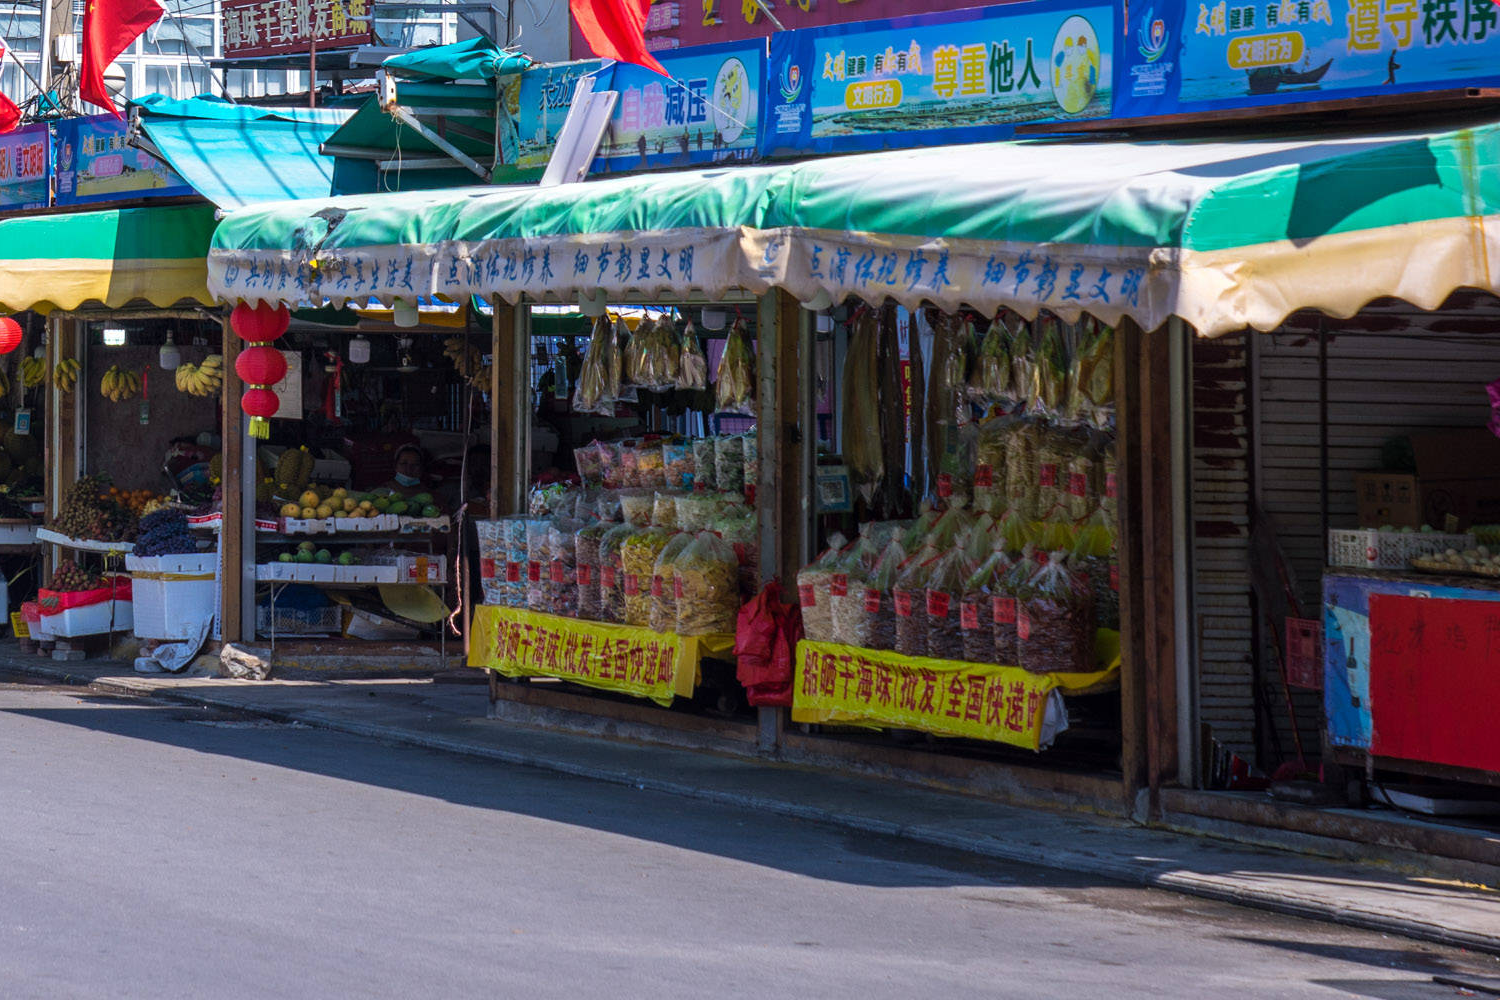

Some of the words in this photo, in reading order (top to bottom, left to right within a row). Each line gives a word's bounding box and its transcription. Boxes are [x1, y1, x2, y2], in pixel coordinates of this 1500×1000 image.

[933, 38, 1041, 97] 尊重他人
[622, 78, 708, 131] 自我减压
[810, 246, 950, 293] 点滴体现修养
[981, 250, 1145, 308] 细节彰显文明
